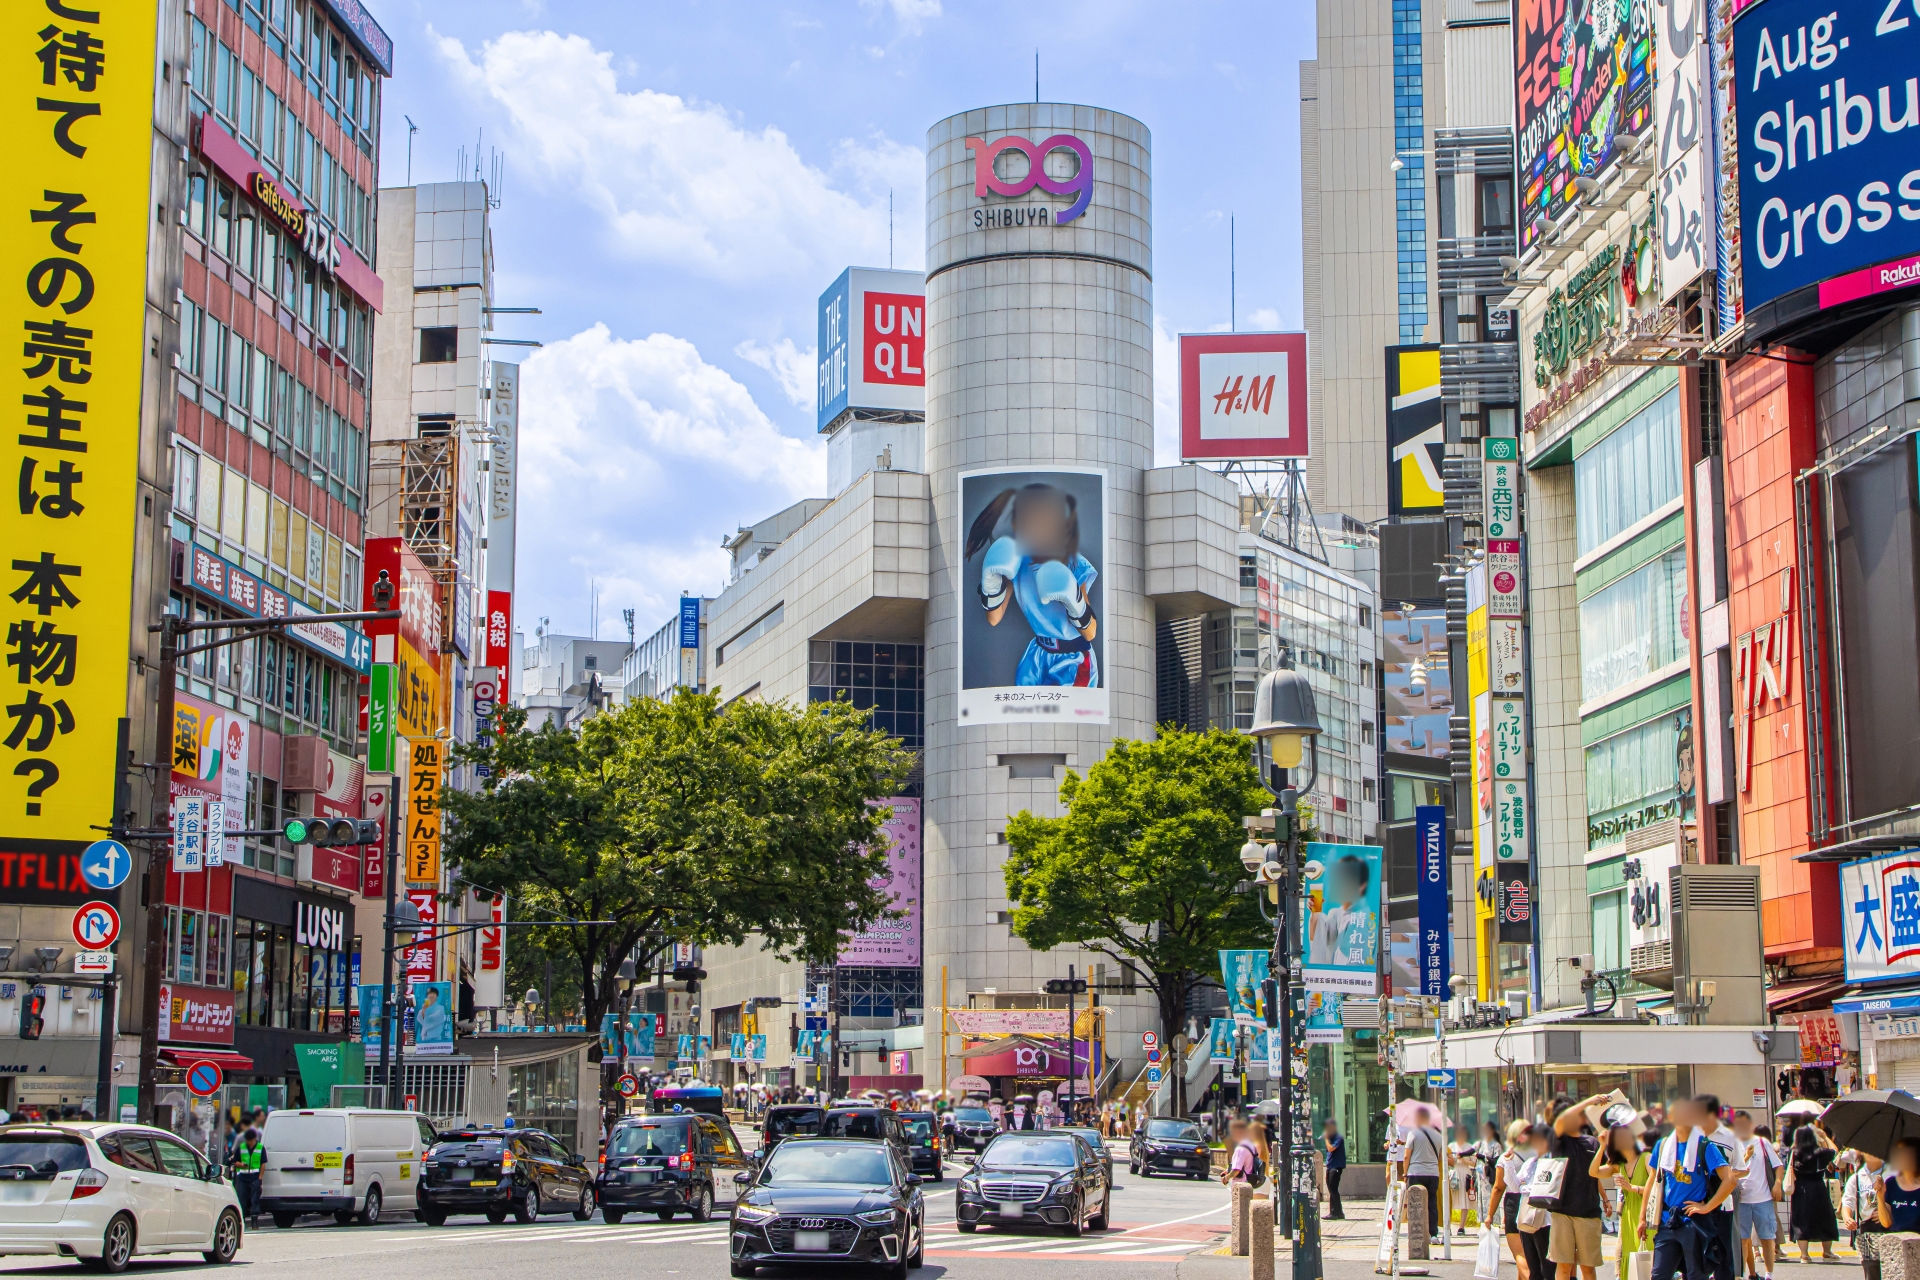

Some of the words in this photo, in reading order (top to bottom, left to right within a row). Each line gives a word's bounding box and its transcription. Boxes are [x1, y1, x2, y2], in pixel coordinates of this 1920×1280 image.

[1753, 11, 1849, 93] Aug.
[1580, 52, 1613, 122] tinder
[1520, 119, 1538, 171] 8.10
[1546, 94, 1557, 140] 16
[1754, 77, 1920, 183] Shibu
[965, 134, 1094, 225] 109
[974, 207, 1048, 227] SHIBUYA
[303, 211, 341, 275] ガスト
[826, 295, 842, 353] THE
[874, 304, 922, 337] UN
[18, 188, 97, 519] その売主は
[874, 342, 925, 378] QL
[495, 376, 513, 416] BIC
[819, 343, 846, 412] PRIME
[1213, 375, 1276, 416] H&M
[493, 420, 513, 519] CAMERA
[1492, 465, 1513, 522] 渋谷西村
[1492, 526, 1501, 534] 5F
[1496, 542, 1512, 552] 4F
[309, 549, 321, 579] 5F
[1490, 554, 1508, 563] 渋谷
[1490, 563, 1519, 571] クリニック
[196, 553, 222, 591] 薄毛
[231, 571, 255, 609] 抜毛
[262, 589, 285, 617] 発毛
[351, 635, 370, 670] 4F
[399, 565, 442, 657] スギ薬局
[490, 611, 507, 648] 免税
[684, 604, 696, 619] THE
[683, 621, 696, 646] PRIME
[2, 551, 82, 817] 本物か?
[1496, 640, 1504, 690] レディースクリニック
[372, 699, 386, 734] レイク
[474, 682, 495, 716] OS
[994, 692, 1069, 702] 未来のスーパースター
[174, 709, 198, 771] 薬
[475, 718, 491, 778] 調剤局
[1497, 721, 1509, 761] パーラー
[1510, 715, 1522, 756] フルーツ
[170, 780, 187, 797] DRUG
[1499, 765, 1509, 774] 2F
[413, 744, 438, 839] 処方せん
[177, 812, 186, 842] Shibuya
[186, 802, 199, 866] 渋谷駅前
[210, 804, 222, 864] スクランブル式
[1499, 802, 1511, 843] フルーツ
[1512, 796, 1524, 839] 渋谷西村
[177, 843, 185, 858] Sta.
[331, 858, 342, 880] 3F
[415, 844, 430, 877] 3F
[1427, 822, 1440, 883] MIZUHO
[1502, 846, 1511, 855] 1F
[368, 880, 379, 888] 3F
[1505, 880, 1529, 922] HUB
[296, 901, 344, 951] LUSH
[1855, 874, 1920, 957] 大盛
[1348, 911, 1366, 965] 晴れ風
[1366, 912, 1377, 965] キリンビール
[311, 953, 339, 987] 24
[340, 962, 360, 972] hur
[1427, 929, 1441, 995] みずほ銀行
[190, 1001, 234, 1026] サンドラッグ
[1862, 1000, 1891, 1011] TAISEIDO
[307, 1048, 338, 1056] SMOKING
[1014, 1047, 1050, 1070] 109
[22, 1081, 53, 1090] SHIBUYA
